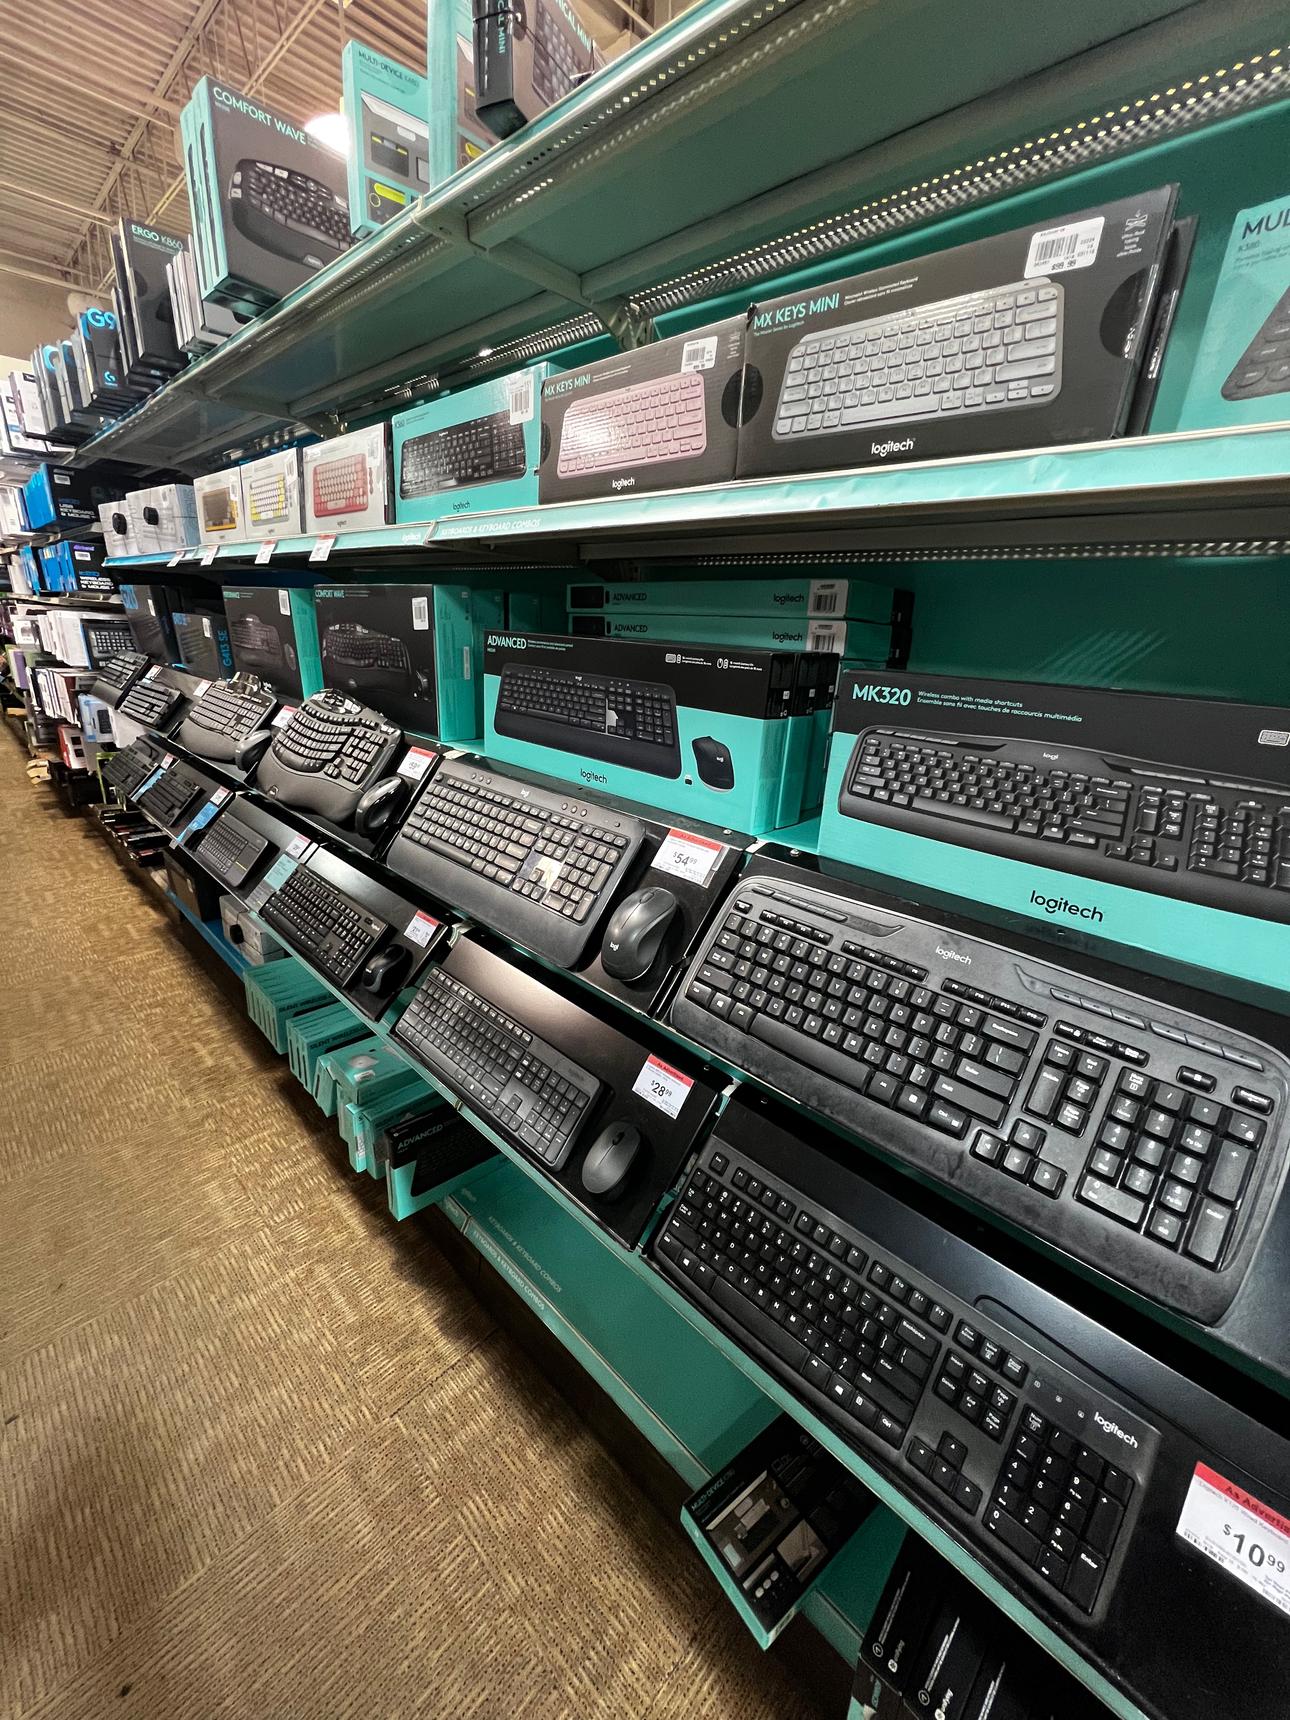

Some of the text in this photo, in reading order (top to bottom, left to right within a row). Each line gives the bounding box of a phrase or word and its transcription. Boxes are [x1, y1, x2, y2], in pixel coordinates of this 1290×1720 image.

[358, 50, 404, 80] MULTI-DEVICE
[214, 87, 306, 144] COMFORT WAVE
[132, 224, 160, 241] ERGO
[160, 236, 183, 250] K860
[754, 312, 772, 330] MX
[776, 303, 806, 323] KEYS
[809, 293, 840, 315] MINI
[544, 386, 555, 396] MX
[556, 380, 573, 393] KEYS
[574, 374, 591, 388] MINI
[871, 438, 914, 458] logitech
[612, 477, 636, 490] logitech
[452, 501, 470, 512] logitech
[612, 592, 647, 601] ADVANCED
[773, 592, 804, 605] logitech
[614, 624, 648, 633] ADVANCED
[772, 631, 803, 642] logitech
[487, 635, 527, 650] ADVANCED
[852, 683, 912, 706] MK320
[994, 700, 1023, 708] shortcuts
[1011, 709, 1042, 718] raccourcis
[1044, 713, 1082, 722] multimédia
[580, 768, 608, 784] logitech
[1030, 890, 1103, 922] logitech
[936, 945, 972, 965] logitech
[397, 1123, 443, 1150] ADVANCED
[1094, 1412, 1138, 1448] logitech
[1225, 1486, 1240, 1500] As
[993, 1510, 1000, 1519] 0
[1028, 1506, 1034, 1515] 2
[1081, 1553, 1098, 1569] Enter
